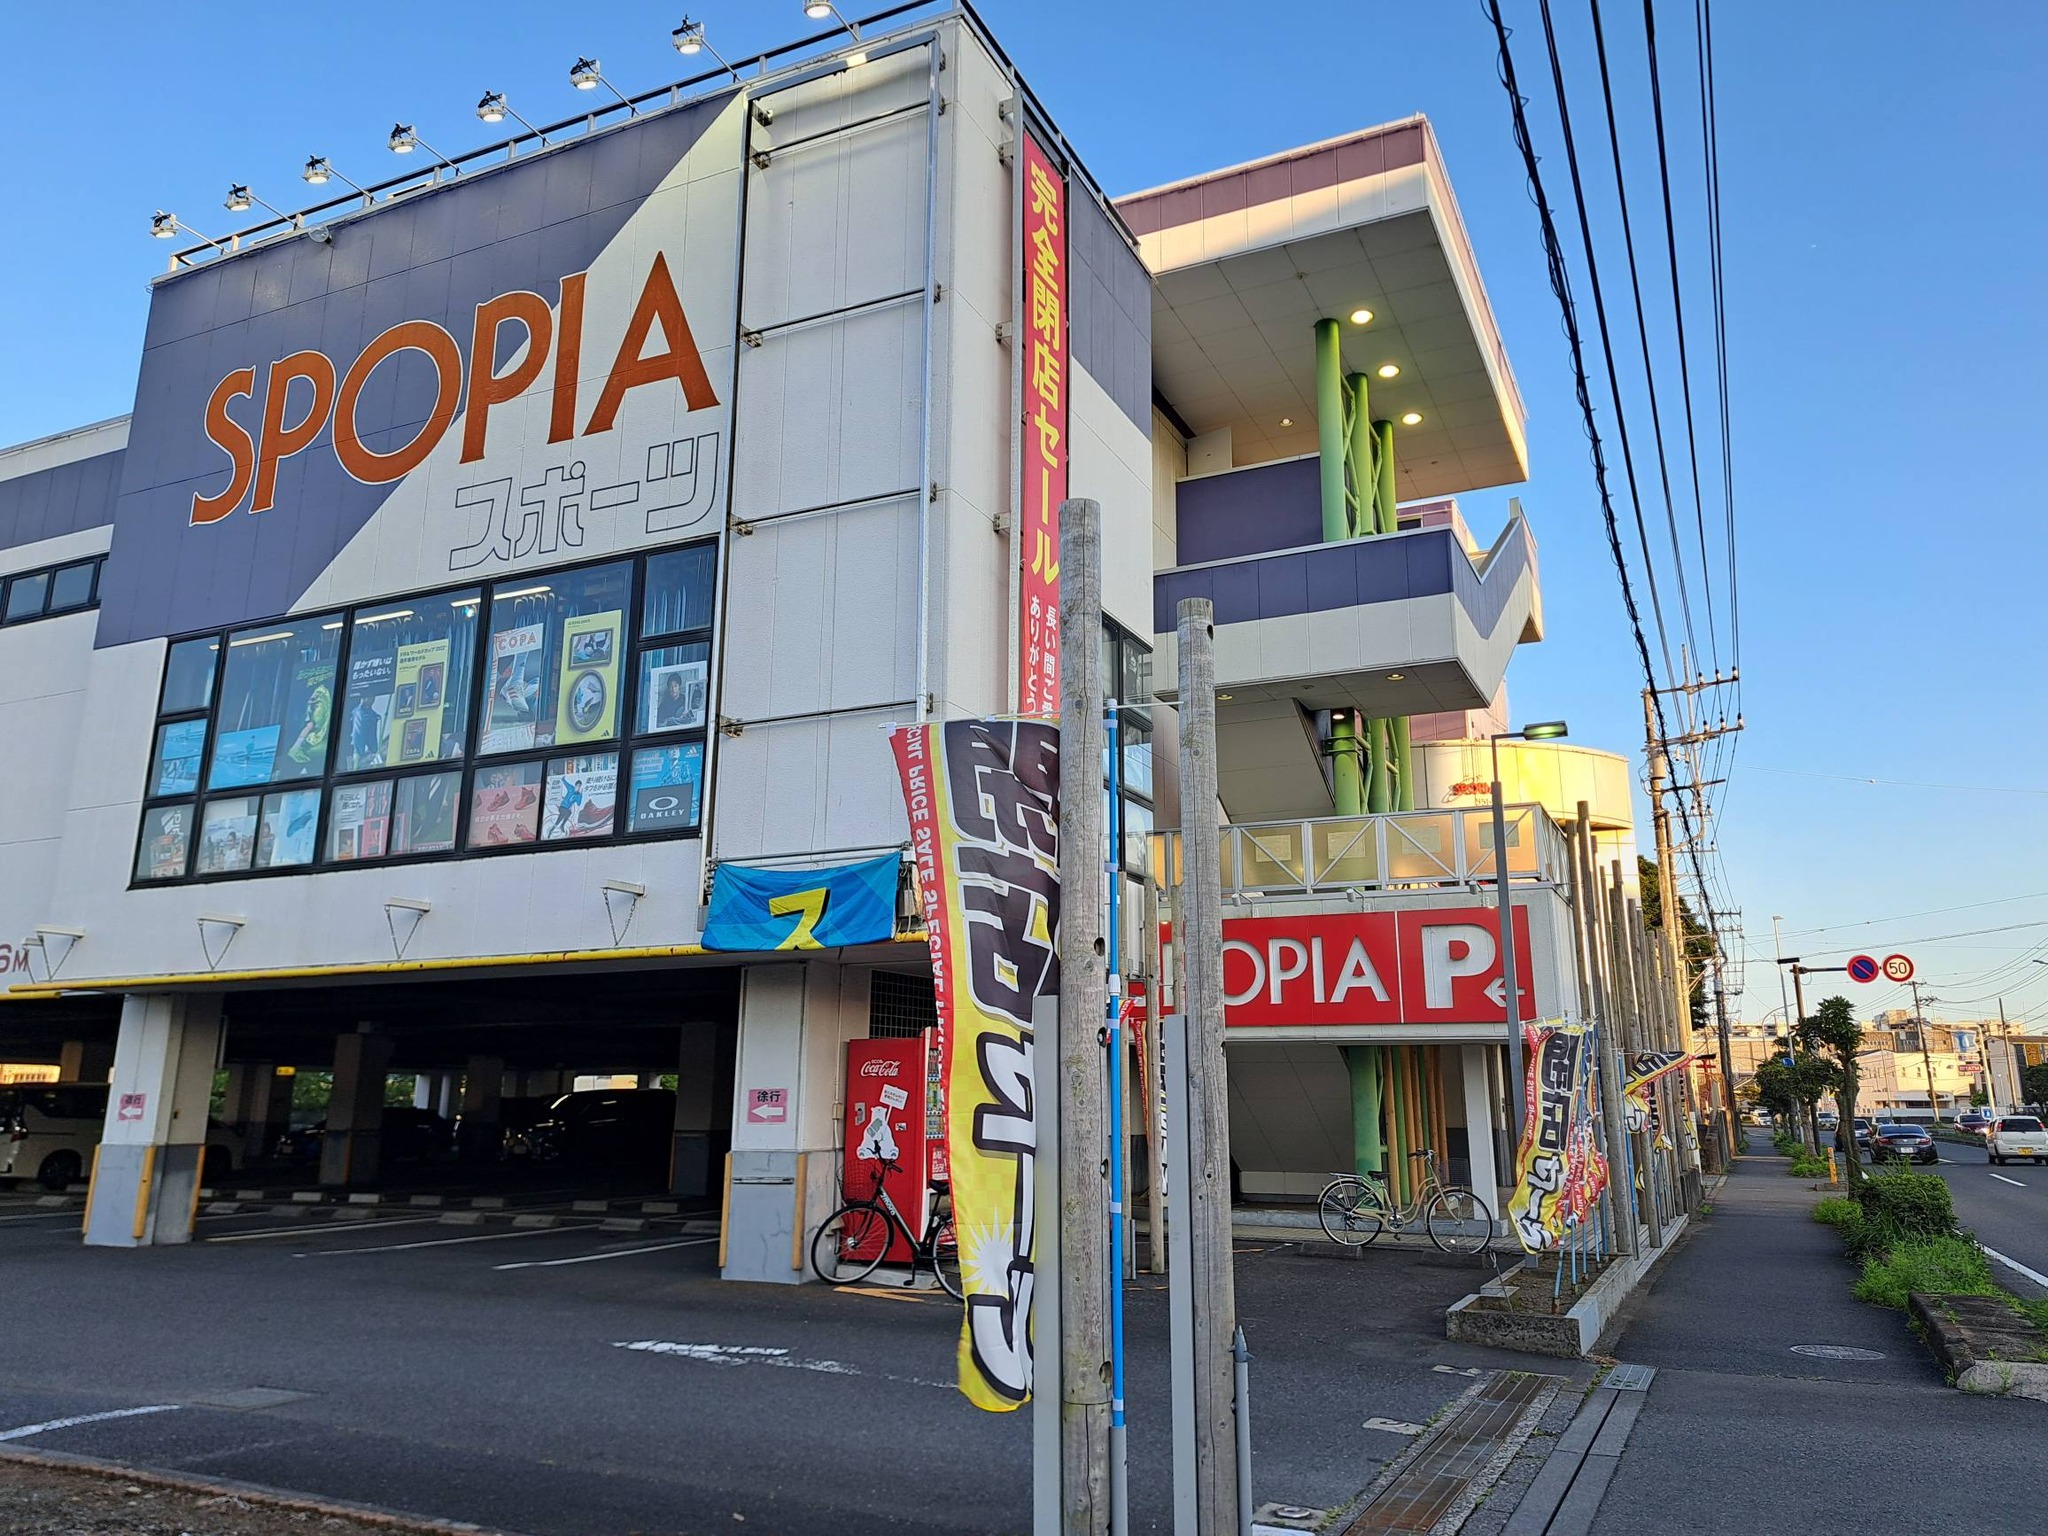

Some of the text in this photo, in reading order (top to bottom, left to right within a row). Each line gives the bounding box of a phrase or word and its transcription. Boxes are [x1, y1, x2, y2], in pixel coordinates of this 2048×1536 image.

[188, 250, 721, 528] SPOPIA
[1030, 159, 1060, 586] 完全閉店セール
[448, 431, 720, 571] スポーツ
[499, 631, 537, 651] COPA
[640, 809, 685, 820] OAKLEY
[1162, 934, 1392, 1007] OPIA
[1421, 923, 1497, 1009] P
[1889, 962, 1907, 975] 50
[757, 1090, 781, 1102] 徐行
